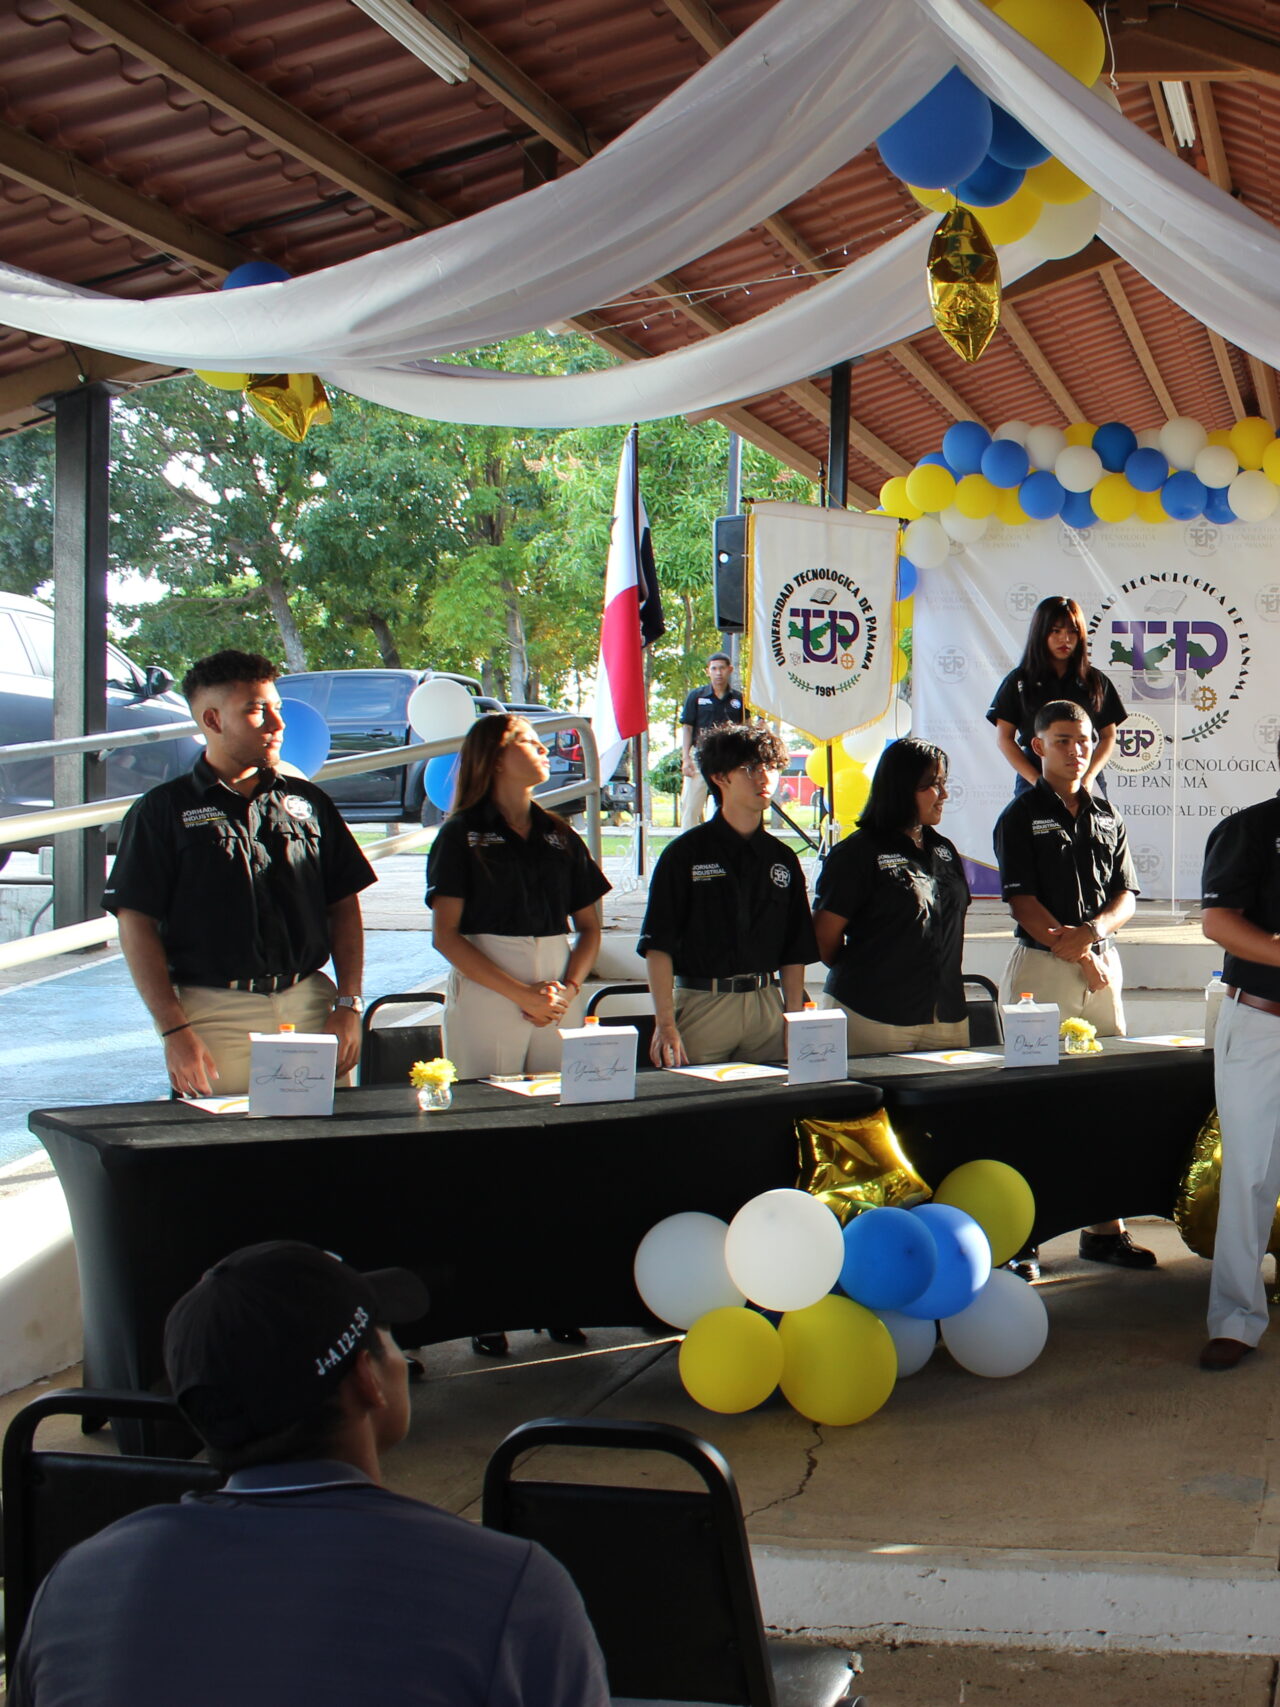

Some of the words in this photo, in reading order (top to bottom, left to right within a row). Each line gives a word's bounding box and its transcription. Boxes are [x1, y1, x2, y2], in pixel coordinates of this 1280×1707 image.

[793, 568, 860, 599] TECNOLOGICA
[1121, 572, 1228, 606] TECNOLOGICA
[858, 597, 873, 614] DE
[771, 583, 795, 667] UNIVERSIDAD
[1227, 607, 1245, 627] DE
[861, 615, 877, 671] PANAMA
[1229, 632, 1250, 700] PANAMA
[815, 685, 836, 697] 1981
[1164, 756, 1277, 772] TCNOLÓGICA
[1117, 776, 1137, 788] DE
[1142, 773, 1208, 789] PANMÁ
[182, 806, 217, 818] JORNADA
[183, 811, 226, 823] INDUSTRIAL
[1124, 805, 1195, 817] REGIONAL
[1199, 806, 1217, 816] DE
[692, 863, 720, 871] JORNADA
